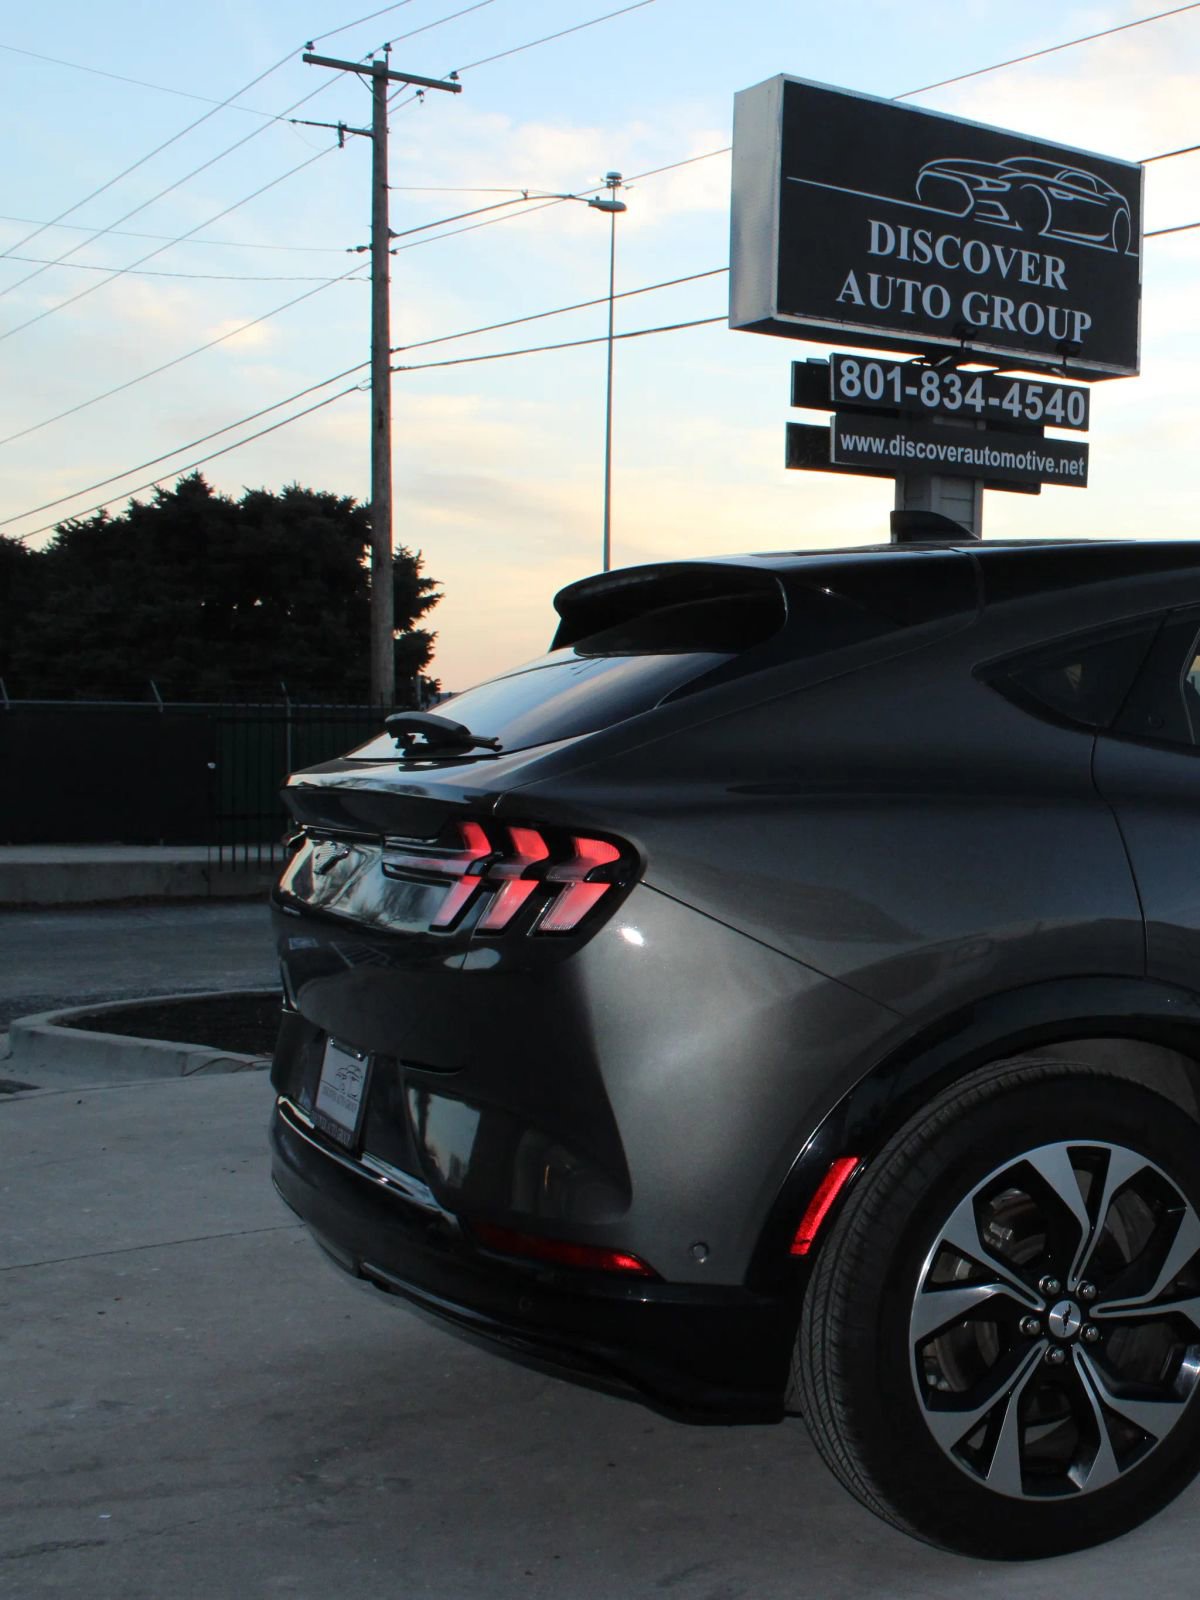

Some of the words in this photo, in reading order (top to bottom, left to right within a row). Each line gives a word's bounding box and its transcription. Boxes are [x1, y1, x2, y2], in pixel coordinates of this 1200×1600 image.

[867, 219, 1069, 291] DISCOVER
[836, 269, 951, 319] AUTO
[961, 291, 1092, 343] GROUP
[839, 359, 1085, 426] 801-834-4540
[840, 433, 1085, 477] www.discoverautomotive.net
